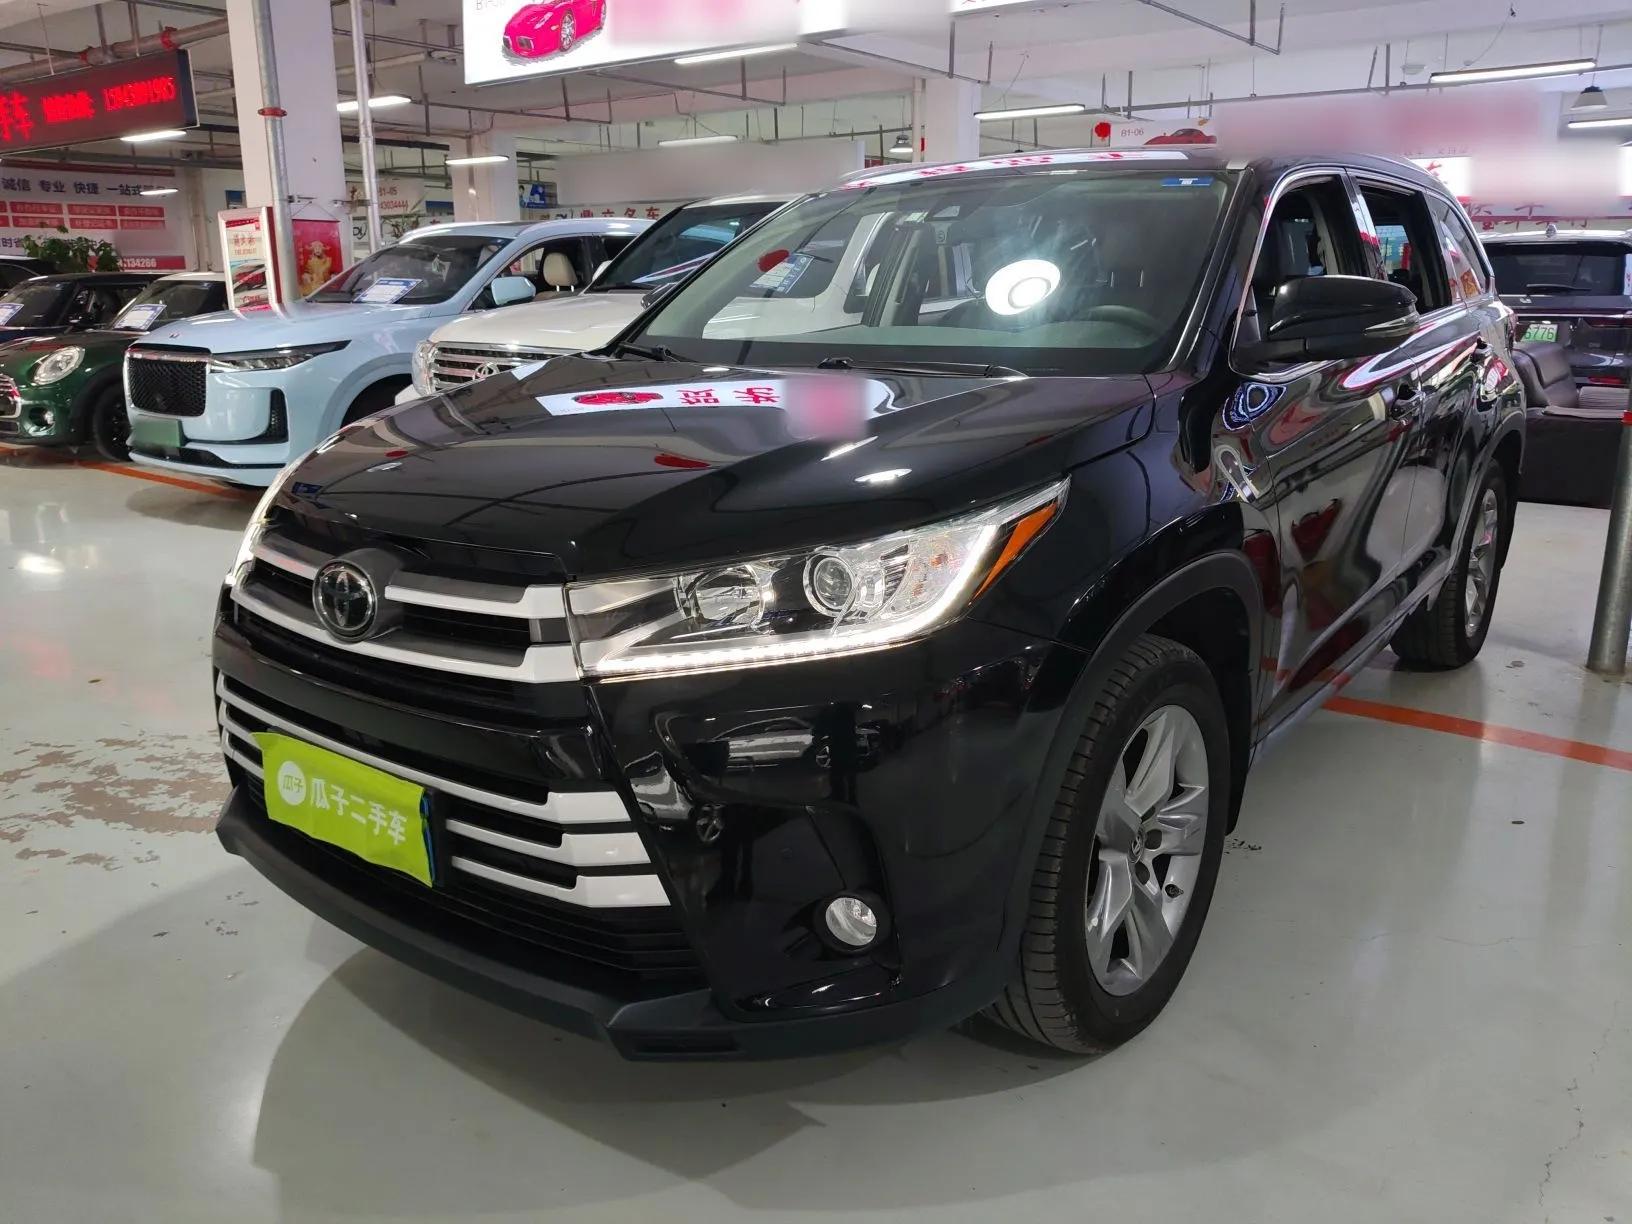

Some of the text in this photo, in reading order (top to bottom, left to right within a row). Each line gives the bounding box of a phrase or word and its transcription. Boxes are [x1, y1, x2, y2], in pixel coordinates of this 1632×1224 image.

[1, 178, 31, 191] 诚信
[39, 180, 66, 193] 专业
[73, 182, 100, 195] 快捷
[282, 773, 304, 793] 瓜子
[310, 777, 407, 846] 瓜子二手车
